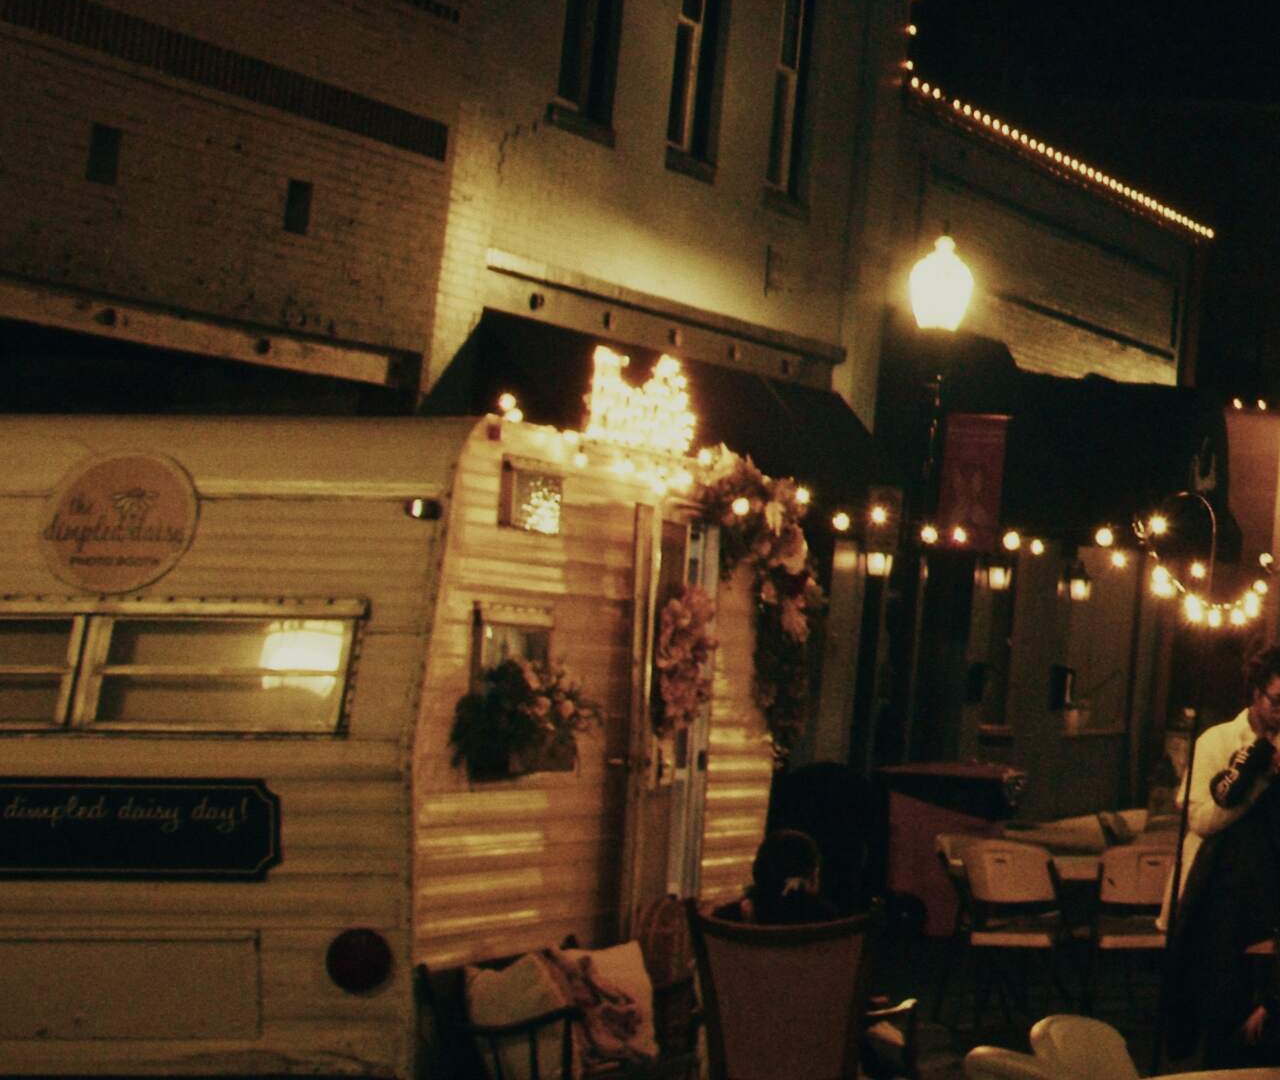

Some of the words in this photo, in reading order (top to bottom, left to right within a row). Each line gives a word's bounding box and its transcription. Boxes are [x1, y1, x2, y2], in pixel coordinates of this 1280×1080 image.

[3, 795, 109, 828] dimpled
[117, 795, 183, 834] daisy
[191, 796, 250, 834] day!
